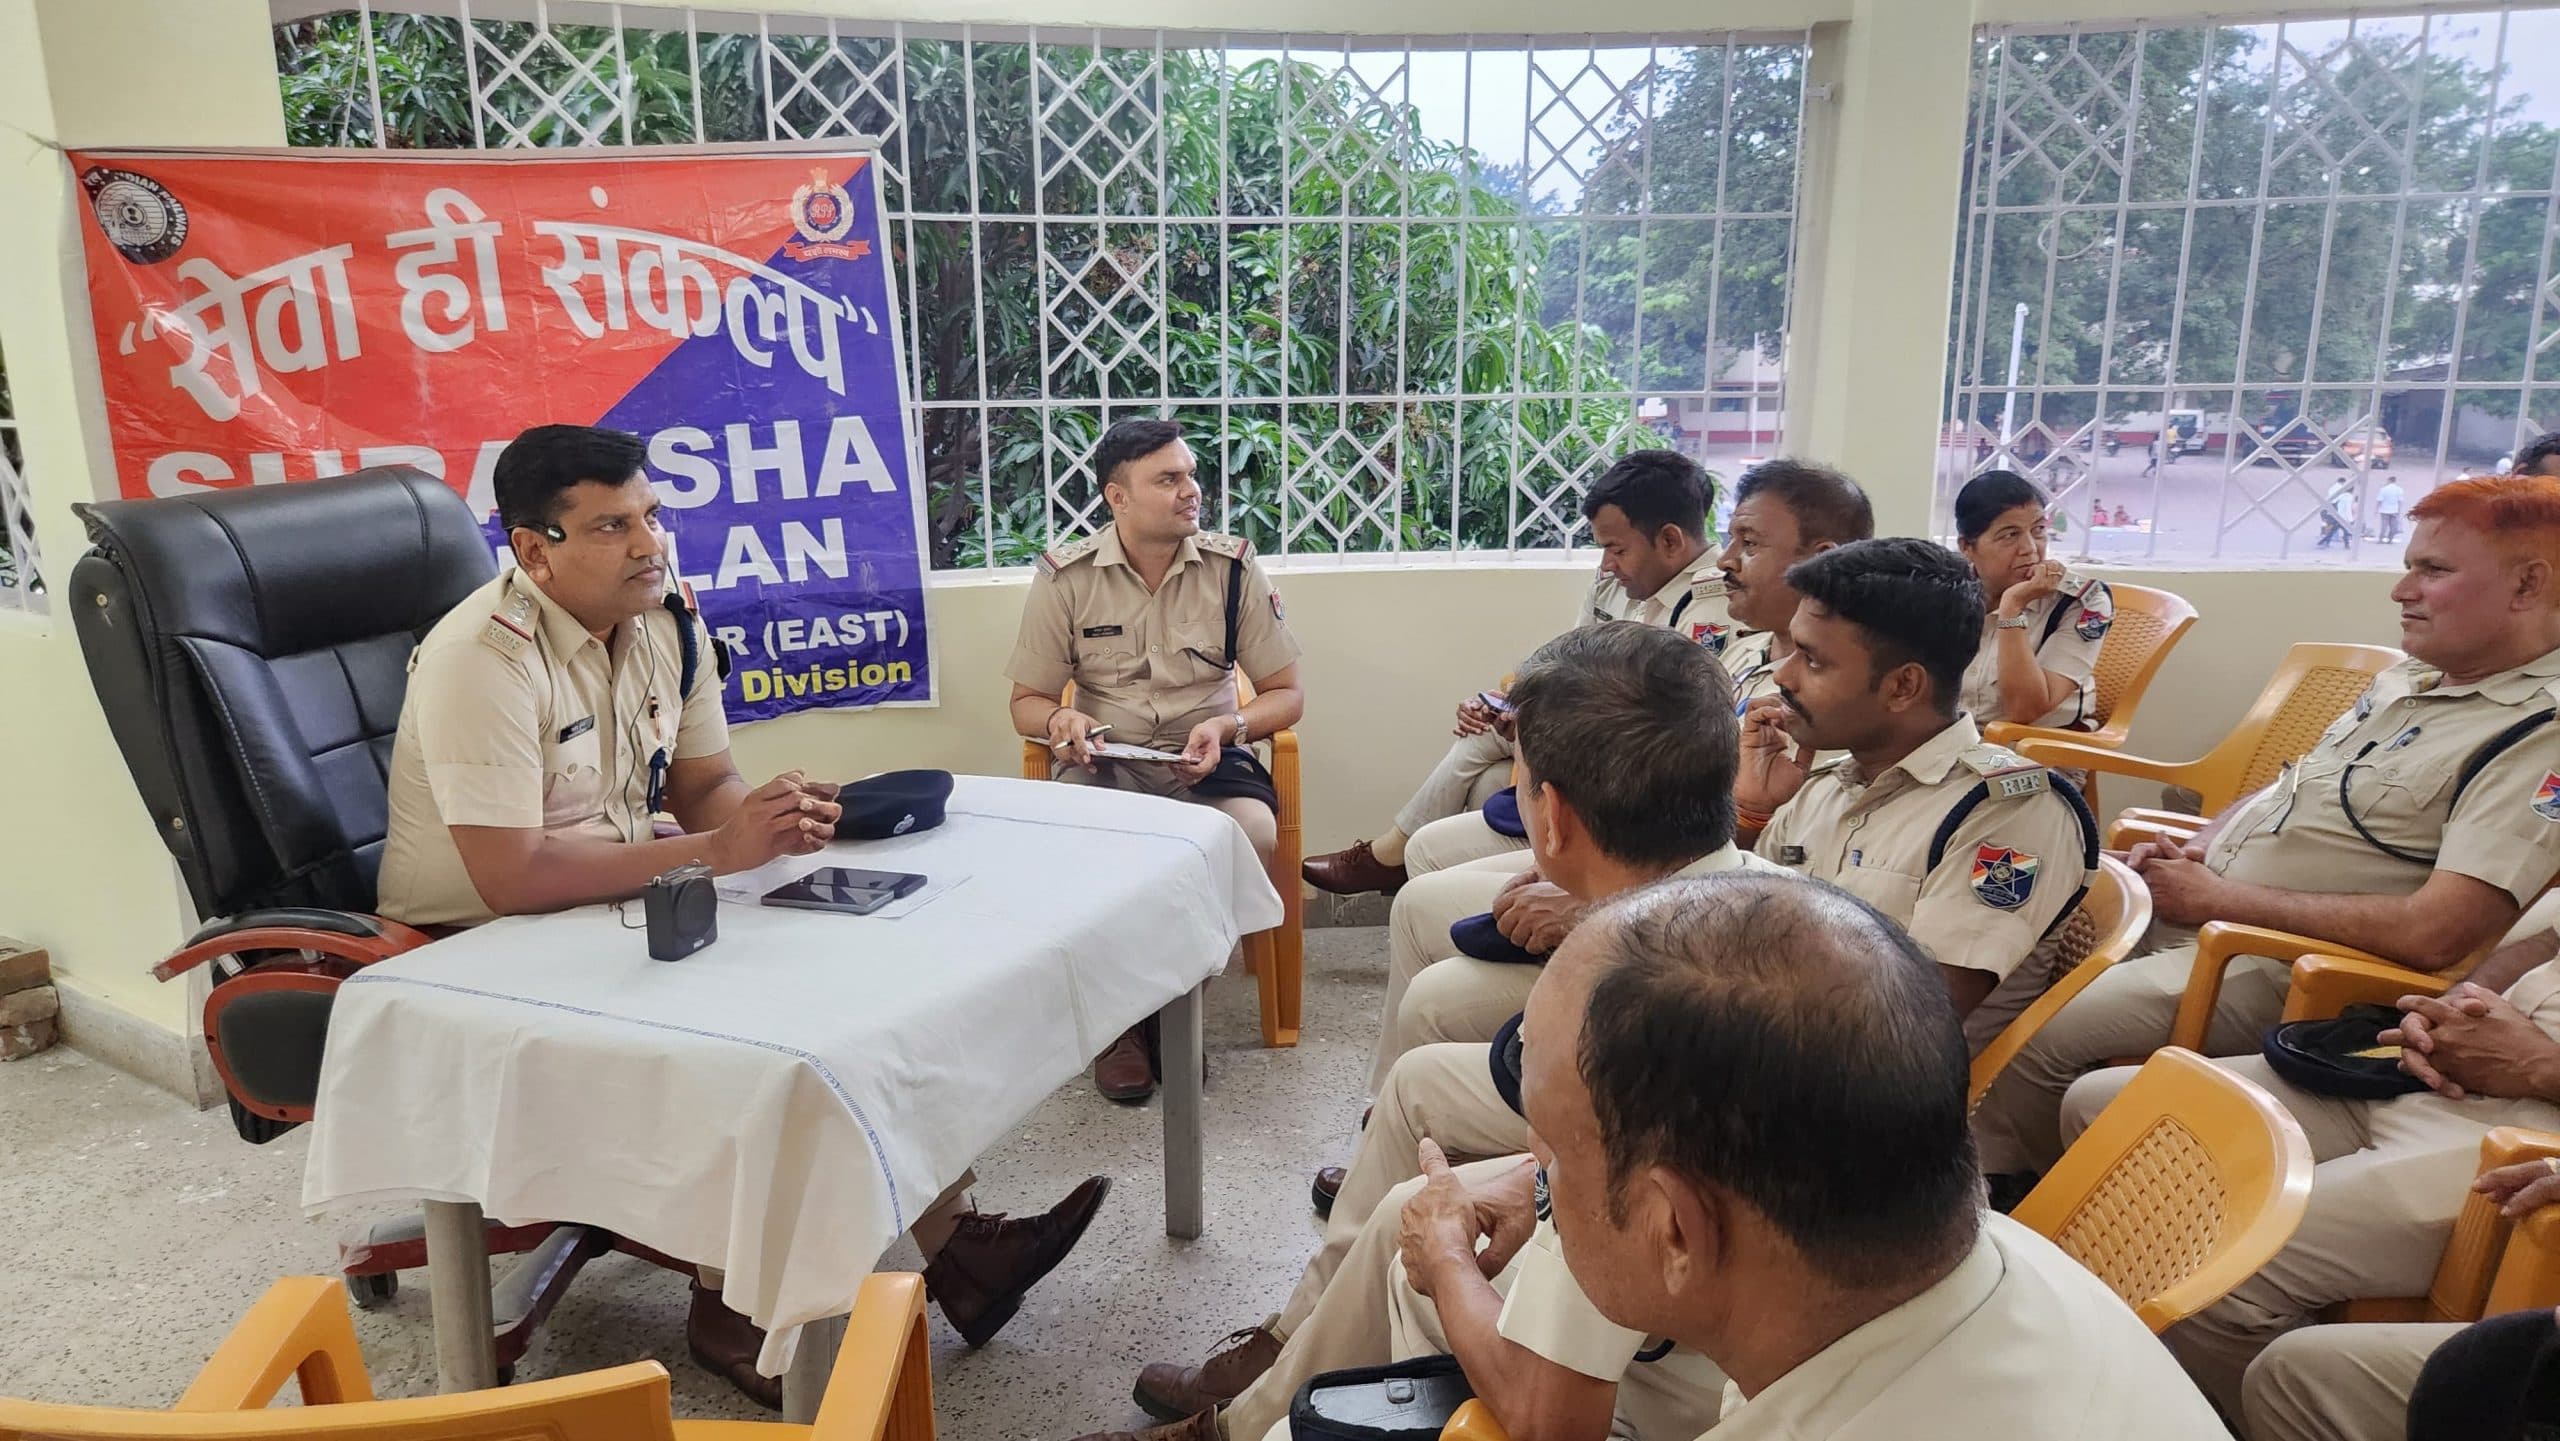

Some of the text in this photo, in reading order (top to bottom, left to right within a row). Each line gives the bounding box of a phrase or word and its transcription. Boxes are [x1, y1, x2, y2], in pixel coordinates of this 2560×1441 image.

[386, 187, 507, 353] ही
[762, 609, 910, 662] (EAST)
[740, 658, 912, 703] Division
